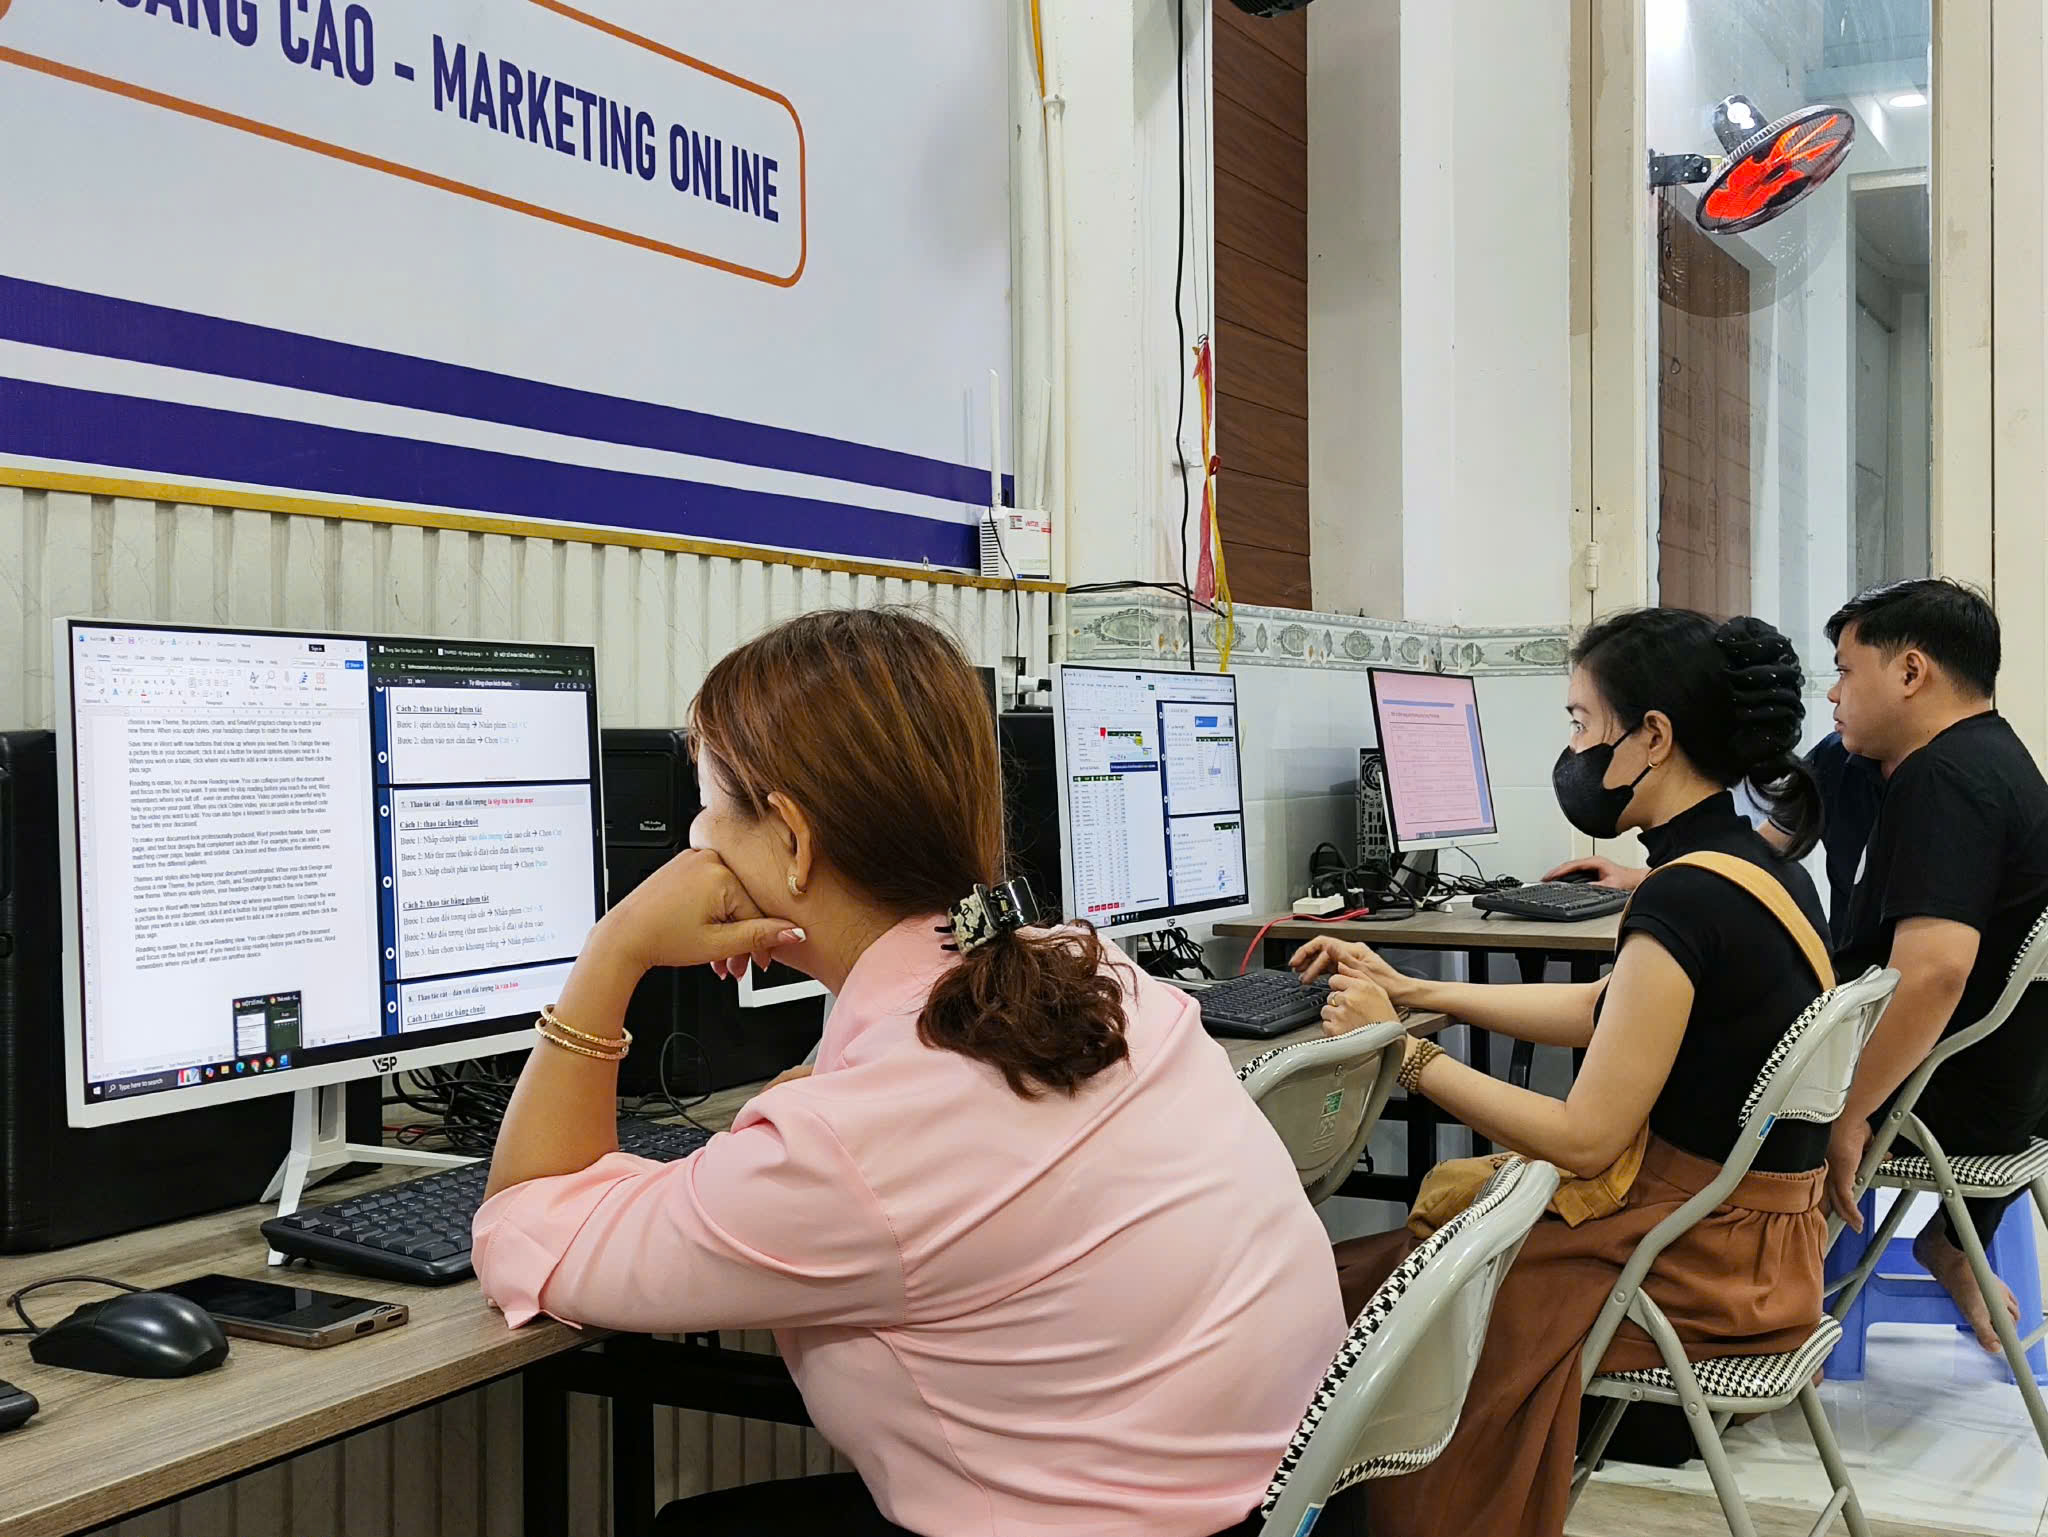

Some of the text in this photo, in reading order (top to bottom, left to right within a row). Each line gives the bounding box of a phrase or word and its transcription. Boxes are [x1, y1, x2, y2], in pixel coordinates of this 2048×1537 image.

[395, 62, 414, 81] -
[433, 34, 656, 181] MARKETING
[669, 124, 779, 223] ONLINE
[372, 1056, 398, 1073] VSP
[119, 1084, 130, 1092] Type
[147, 1078, 163, 1086] search
